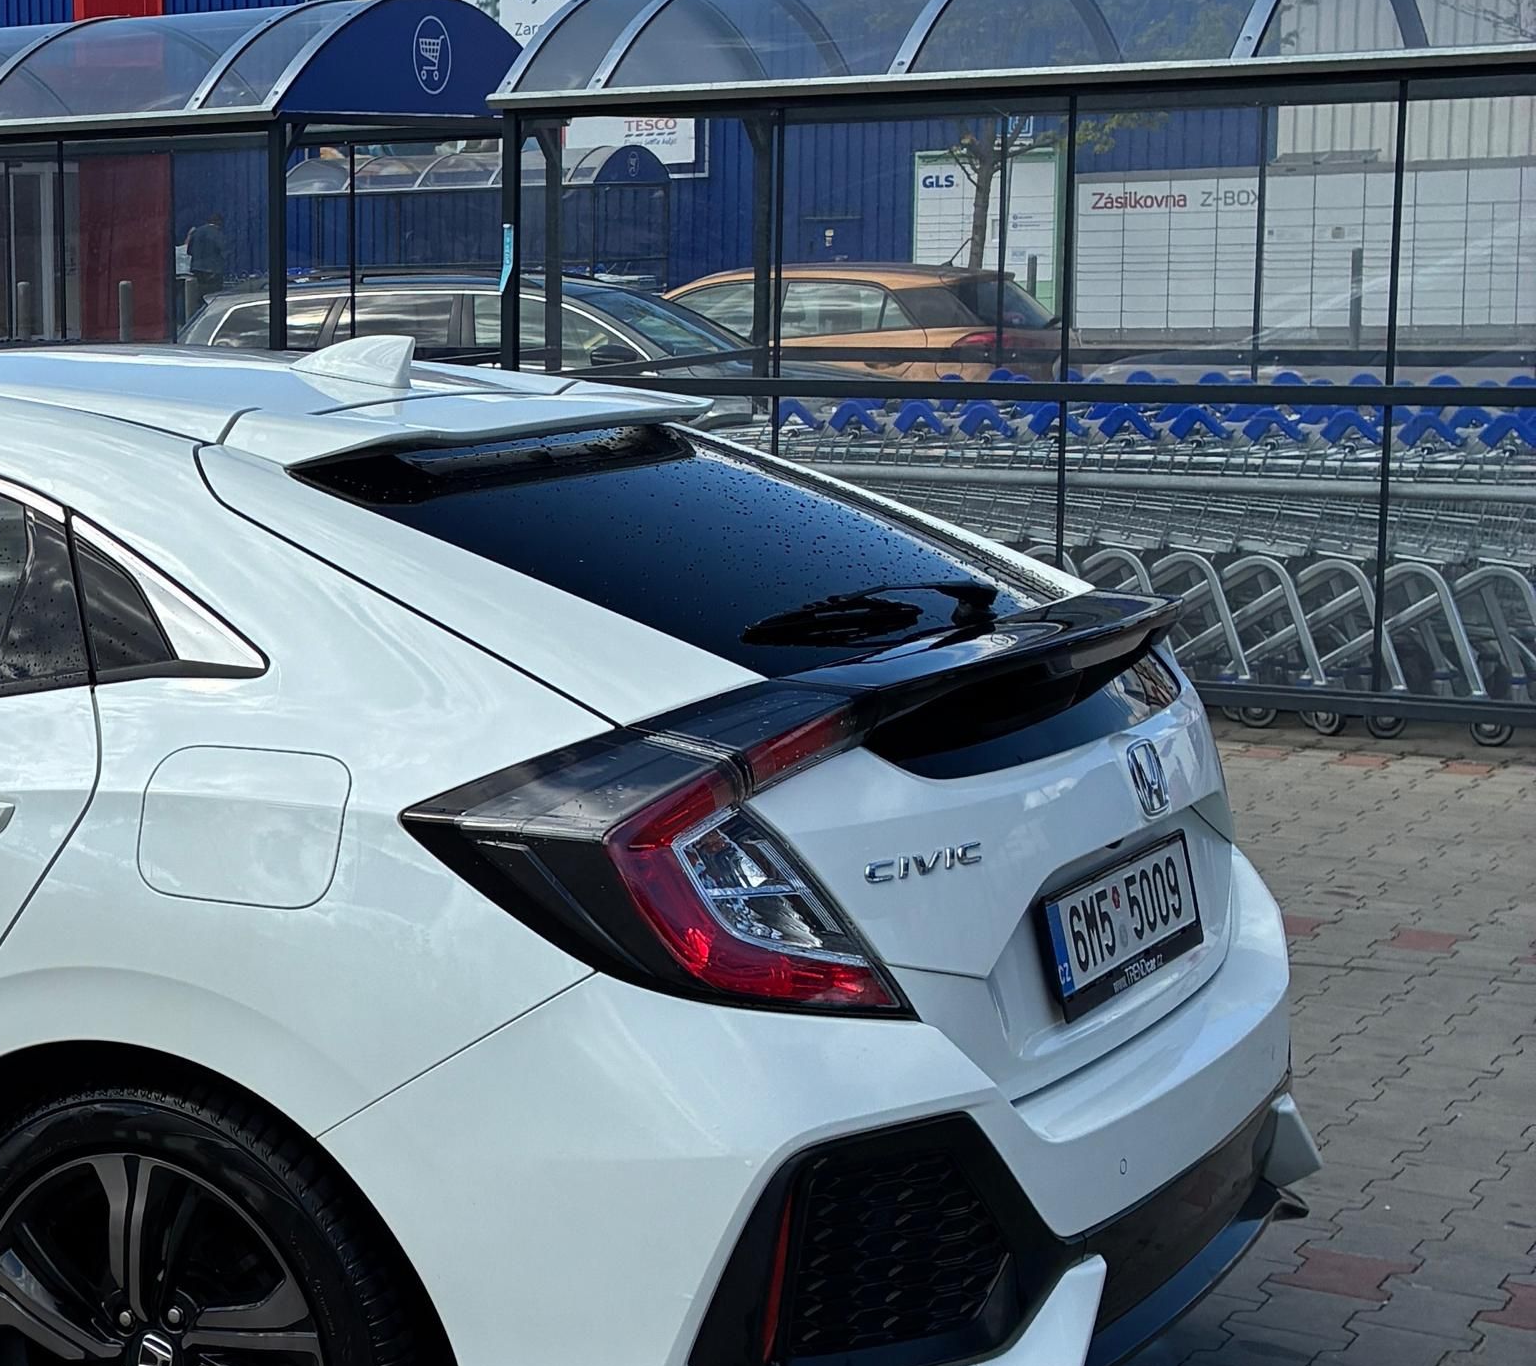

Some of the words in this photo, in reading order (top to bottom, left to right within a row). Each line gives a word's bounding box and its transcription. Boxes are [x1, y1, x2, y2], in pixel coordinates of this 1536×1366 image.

[624, 119, 677, 132] TESCO
[1091, 192, 1187, 210] Zásilkovna
[864, 841, 982, 884] CIVIC
[1069, 888, 1116, 973] 6M5
[1124, 856, 1182, 940] 5009
[1058, 962, 1071, 985] CZ
